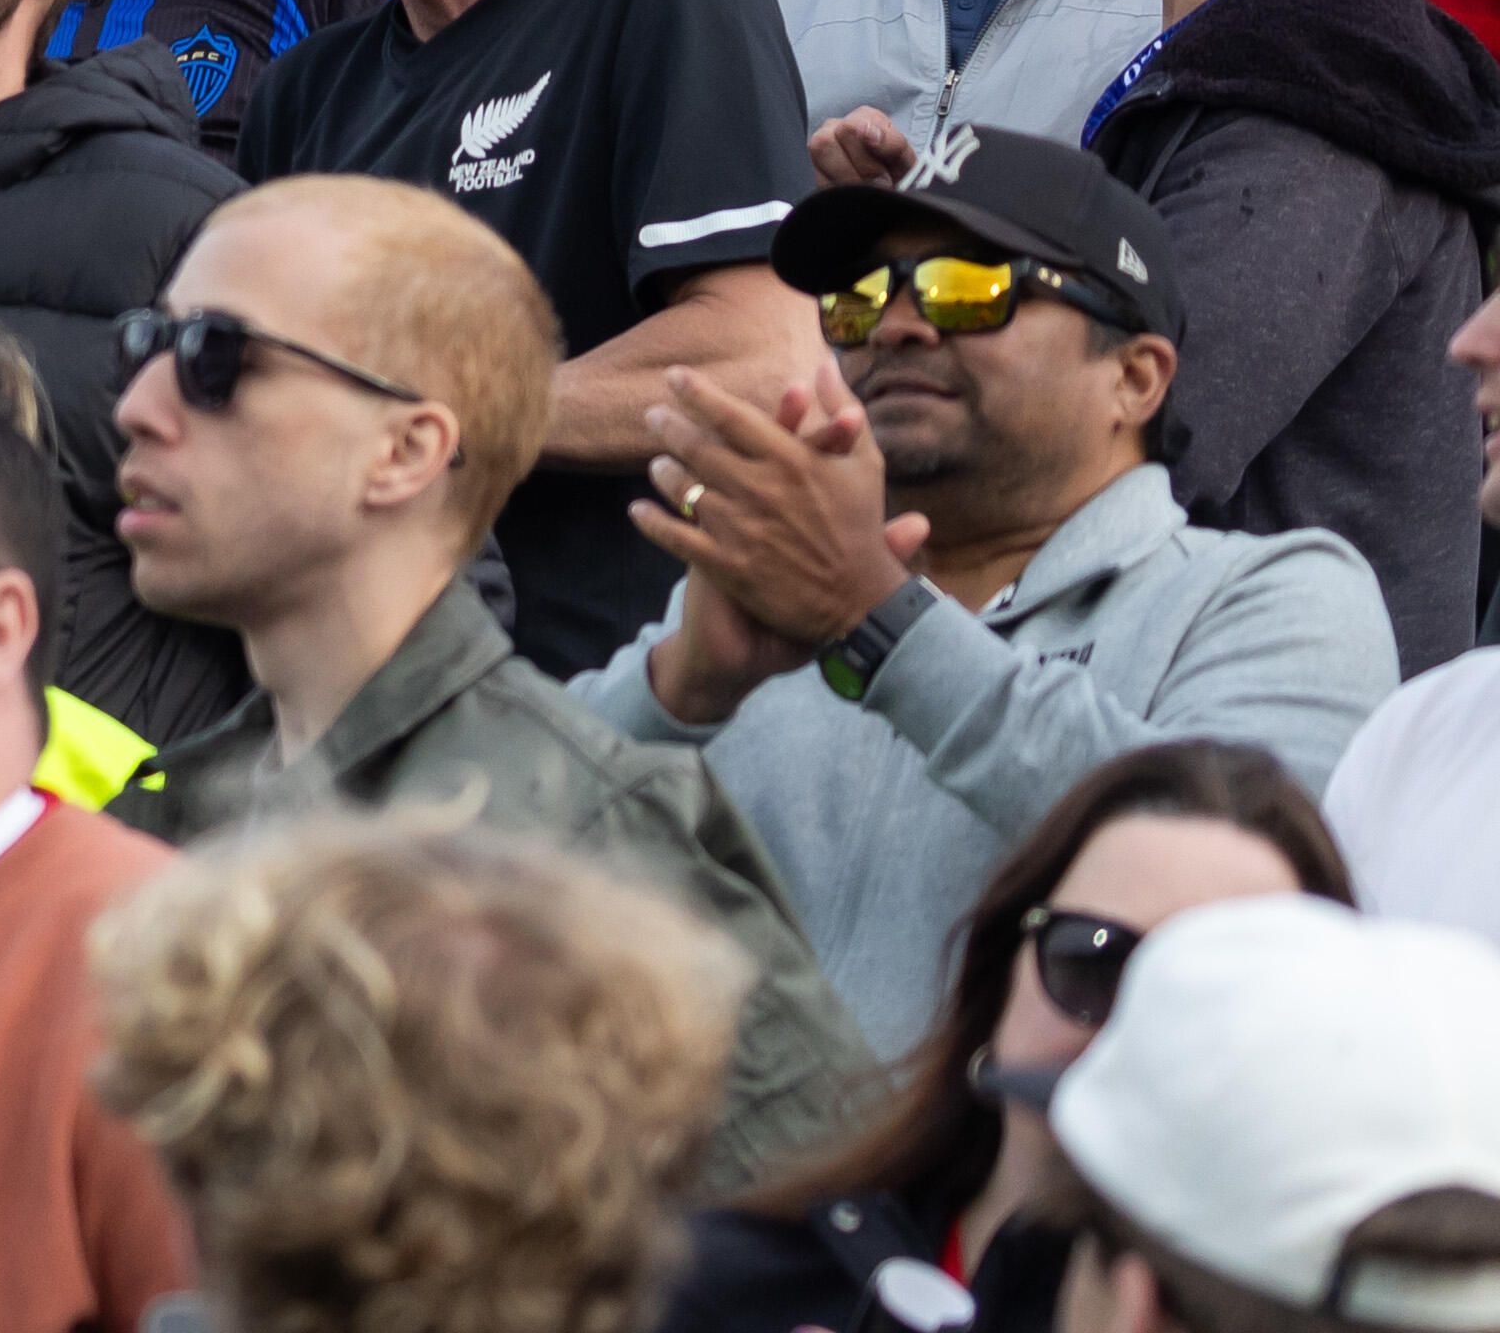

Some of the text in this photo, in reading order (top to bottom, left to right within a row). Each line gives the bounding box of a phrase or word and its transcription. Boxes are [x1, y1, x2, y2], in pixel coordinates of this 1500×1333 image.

[449, 148, 536, 184] NEW ZEALAND
[455, 164, 524, 194] FOOTBALL
